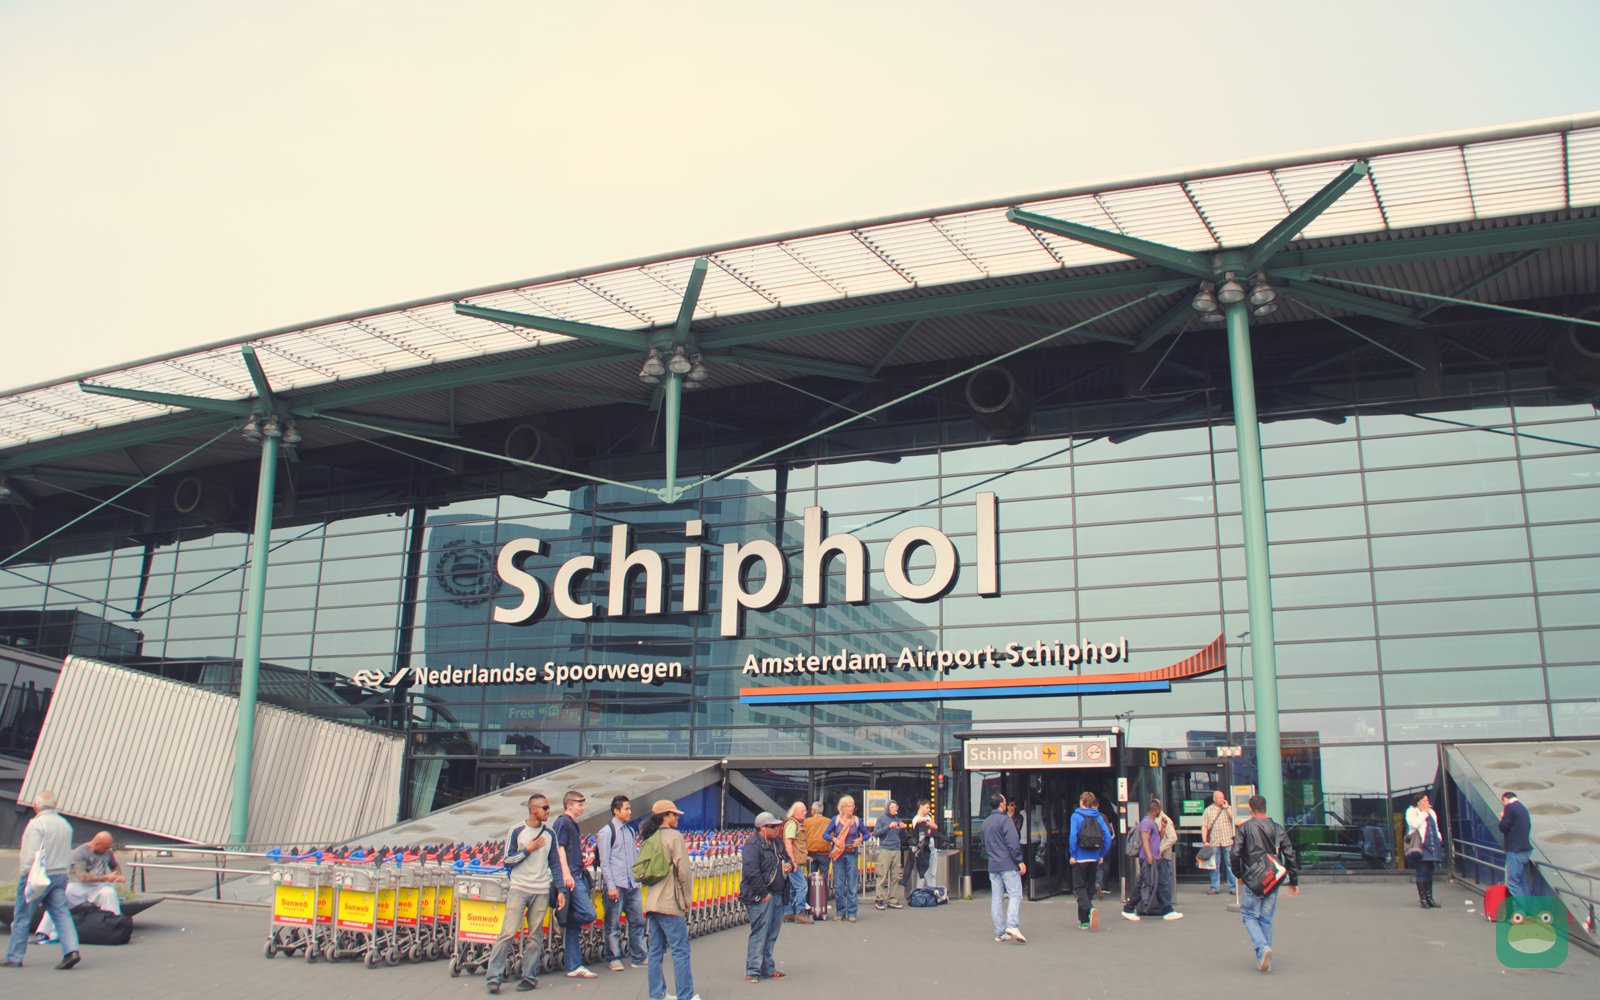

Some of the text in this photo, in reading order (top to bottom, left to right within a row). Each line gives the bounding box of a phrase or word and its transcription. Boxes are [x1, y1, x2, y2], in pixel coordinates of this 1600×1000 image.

[494, 491, 998, 637] Schiphol
[742, 636, 1127, 675] Amsterdam Airport Schiphol
[414, 660, 683, 686] Nederlandse Spoorwegen
[508, 706, 535, 719] Free
[970, 745, 1039, 764] Schiphol
[281, 898, 309, 908] Sunweb
[344, 902, 369, 912] Sunweb
[467, 913, 499, 923] Sunweb
